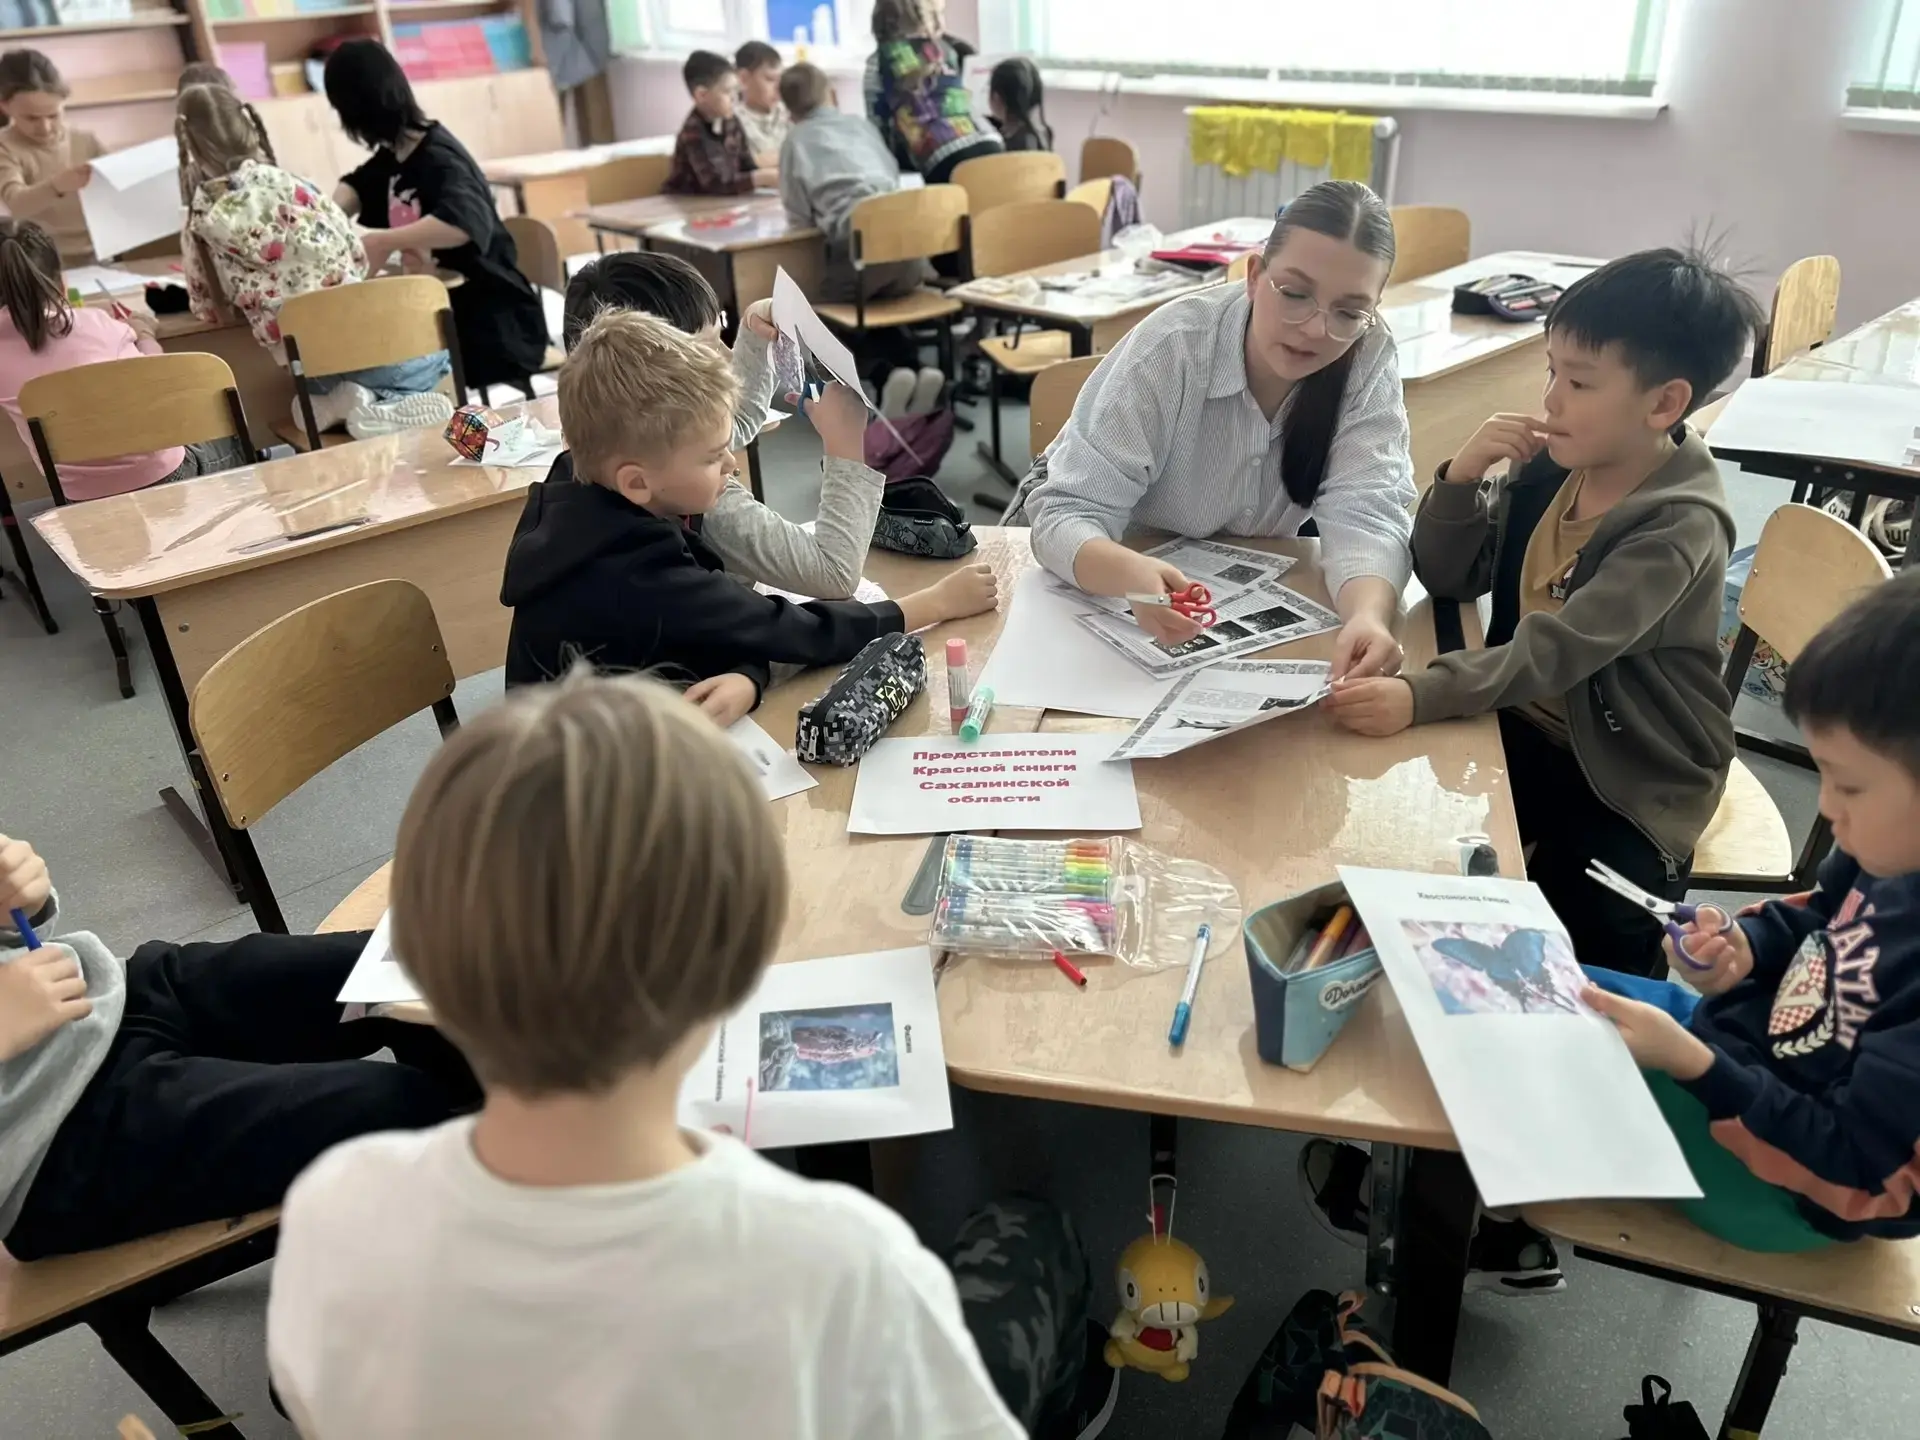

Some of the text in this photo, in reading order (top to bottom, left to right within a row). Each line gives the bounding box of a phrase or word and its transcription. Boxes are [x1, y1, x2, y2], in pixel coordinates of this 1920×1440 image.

[912, 749, 1077, 761] Представители
[912, 763, 1077, 776] Красной книги
[919, 778, 1070, 790] Сахалинской
[947, 795, 1041, 803] области
